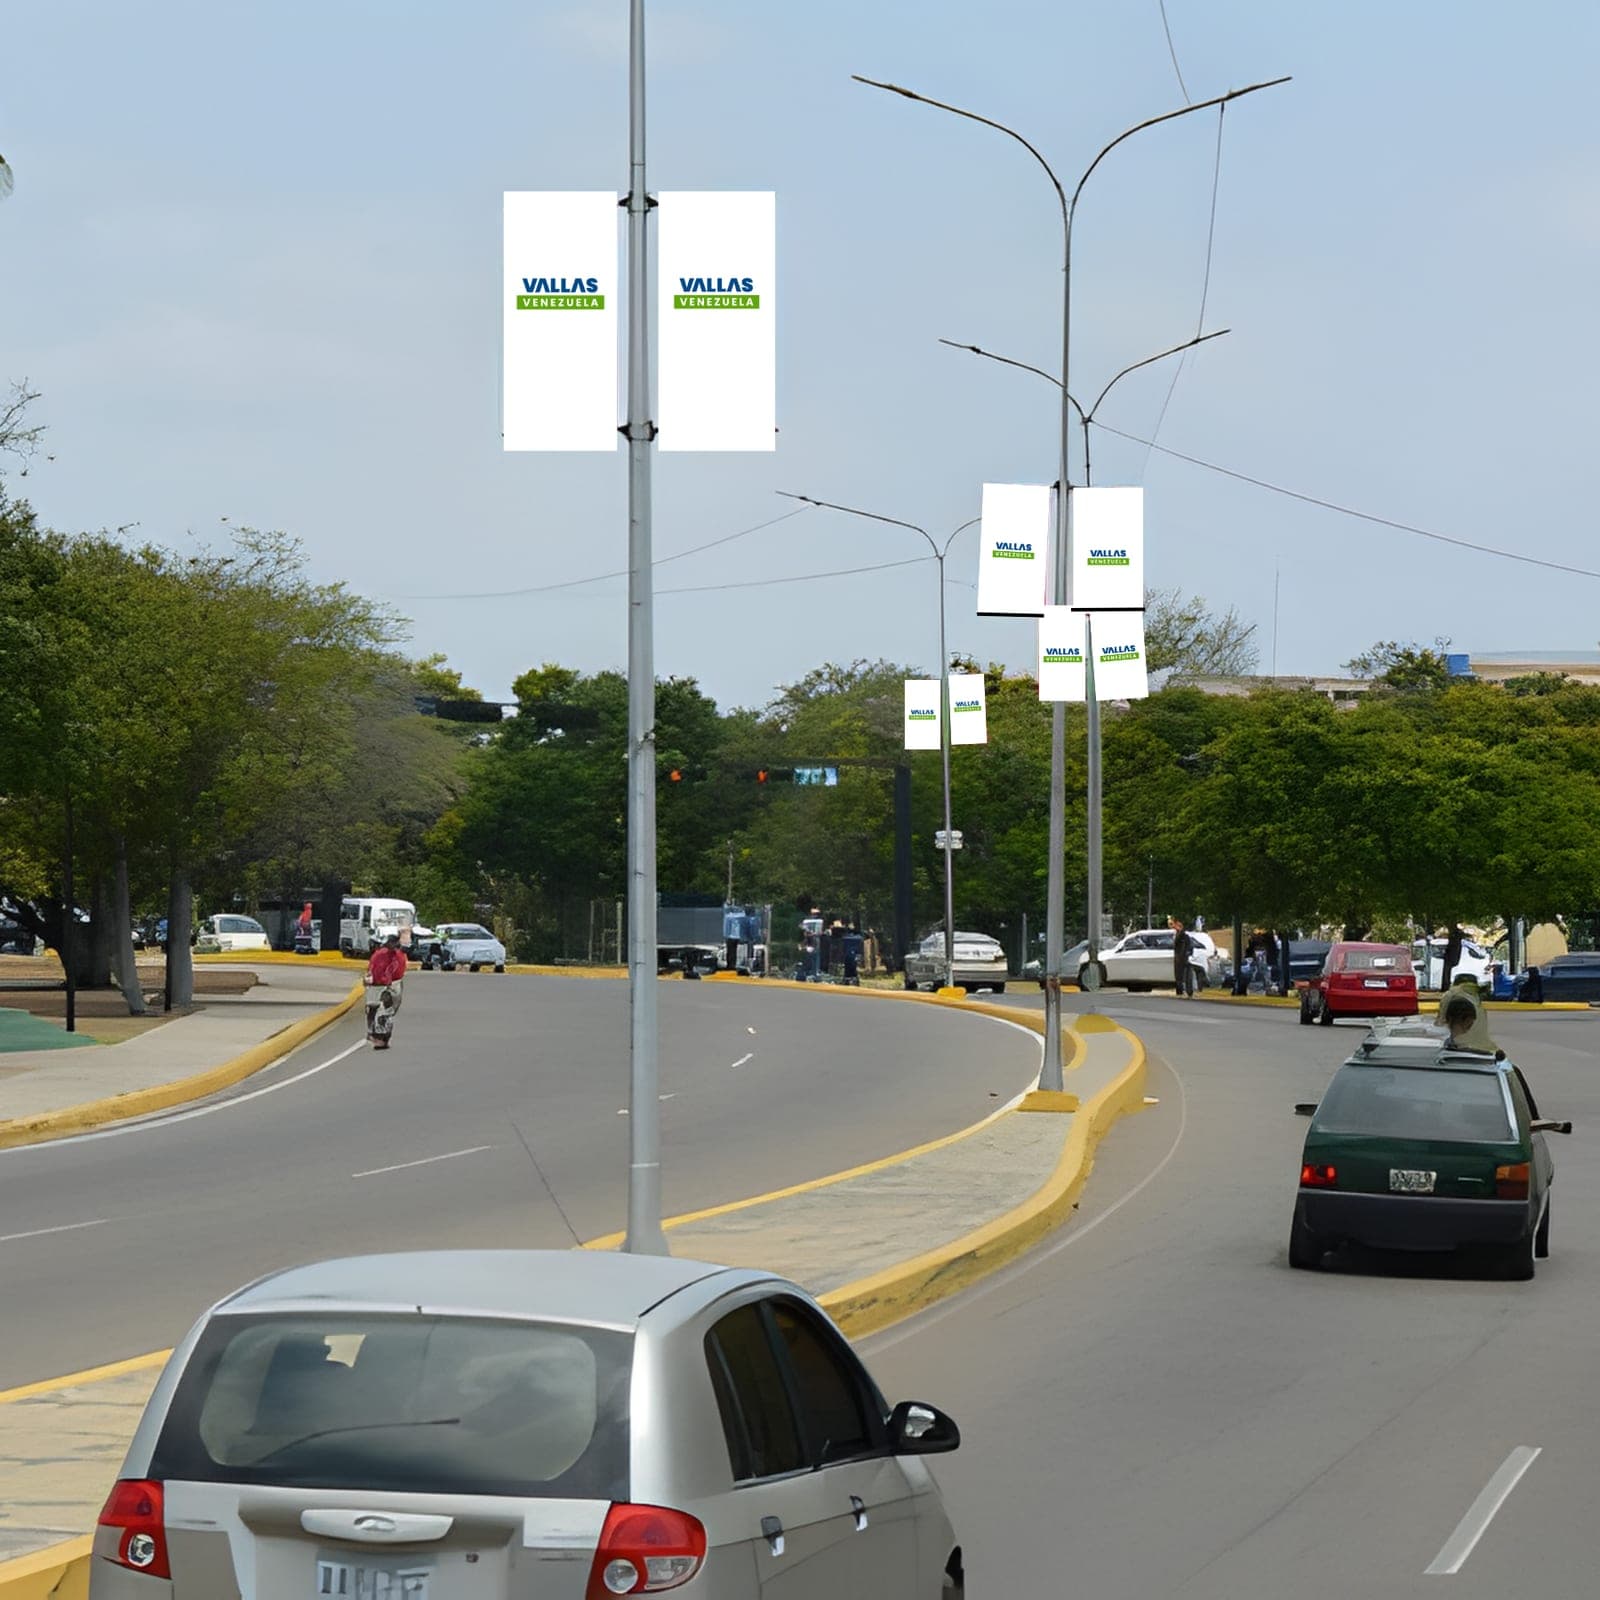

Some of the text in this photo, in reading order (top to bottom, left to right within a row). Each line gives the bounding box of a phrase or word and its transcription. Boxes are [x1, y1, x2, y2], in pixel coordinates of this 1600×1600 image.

[522, 277, 599, 294] VALLAS
[679, 277, 754, 293] VALLAS
[521, 296, 601, 308] VENEZUELA
[678, 296, 756, 308] VENEZUELA
[996, 541, 1033, 551] VALLAS
[1090, 549, 1127, 557] VALLAS
[1046, 647, 1080, 656] VALLAS
[1102, 645, 1136, 655] VALLAS
